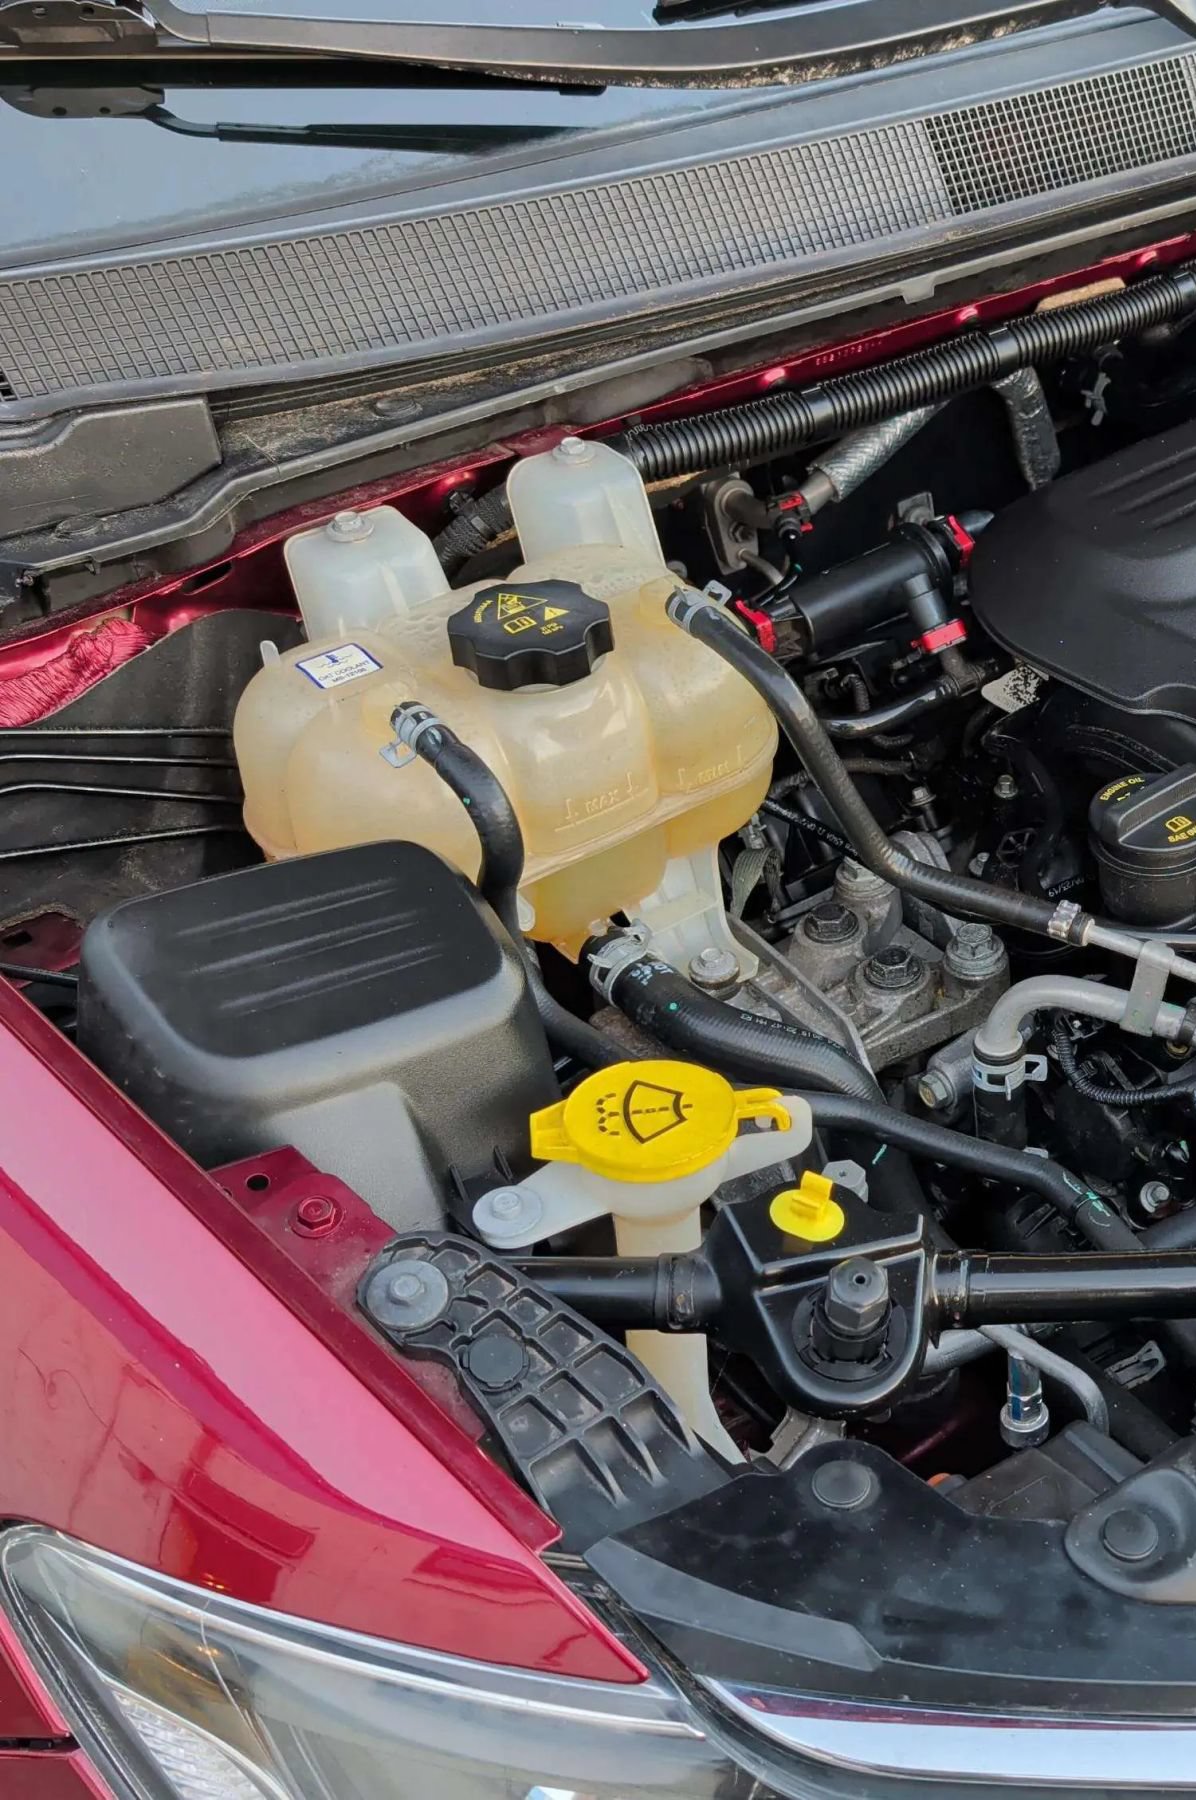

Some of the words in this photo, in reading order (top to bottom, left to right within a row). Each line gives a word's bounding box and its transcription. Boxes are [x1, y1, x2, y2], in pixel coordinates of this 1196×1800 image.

[1100, 780, 1129, 801] ENGINE
[1128, 777, 1145, 785] OIL
[1167, 832, 1188, 843] SAE
